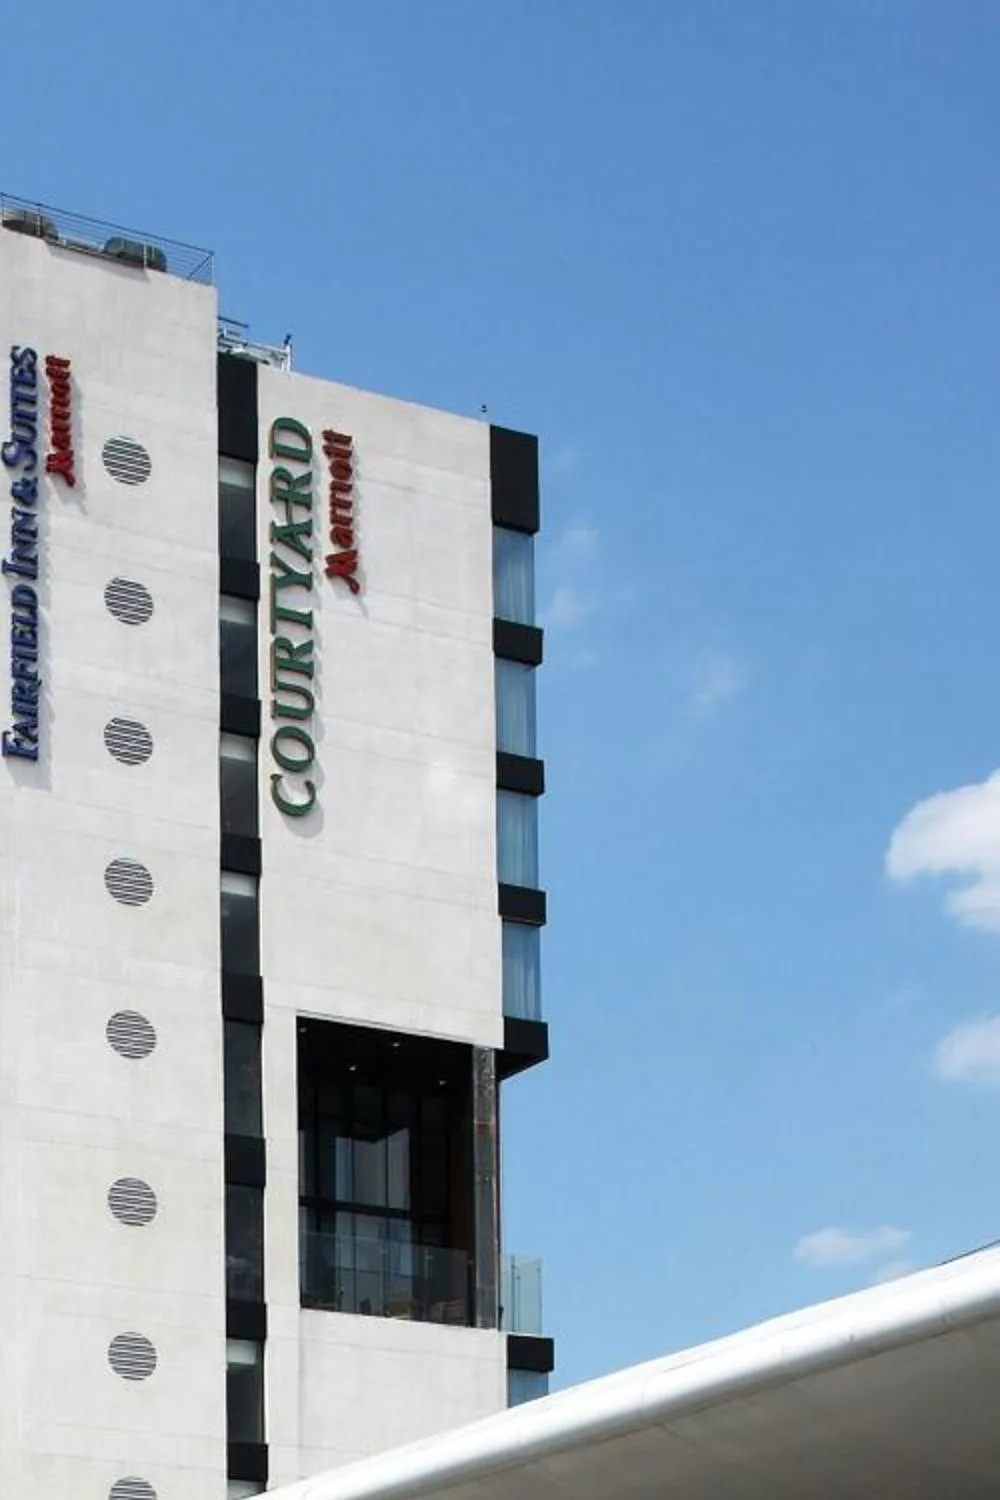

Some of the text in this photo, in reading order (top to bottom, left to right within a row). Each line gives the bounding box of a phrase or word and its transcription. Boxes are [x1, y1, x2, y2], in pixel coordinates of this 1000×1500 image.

[1, 346, 41, 762] FAIRFIELD INN & SUITES
[45, 354, 75, 487] Marriott
[322, 429, 361, 595] Marriott
[269, 416, 316, 818] COURTYARD
